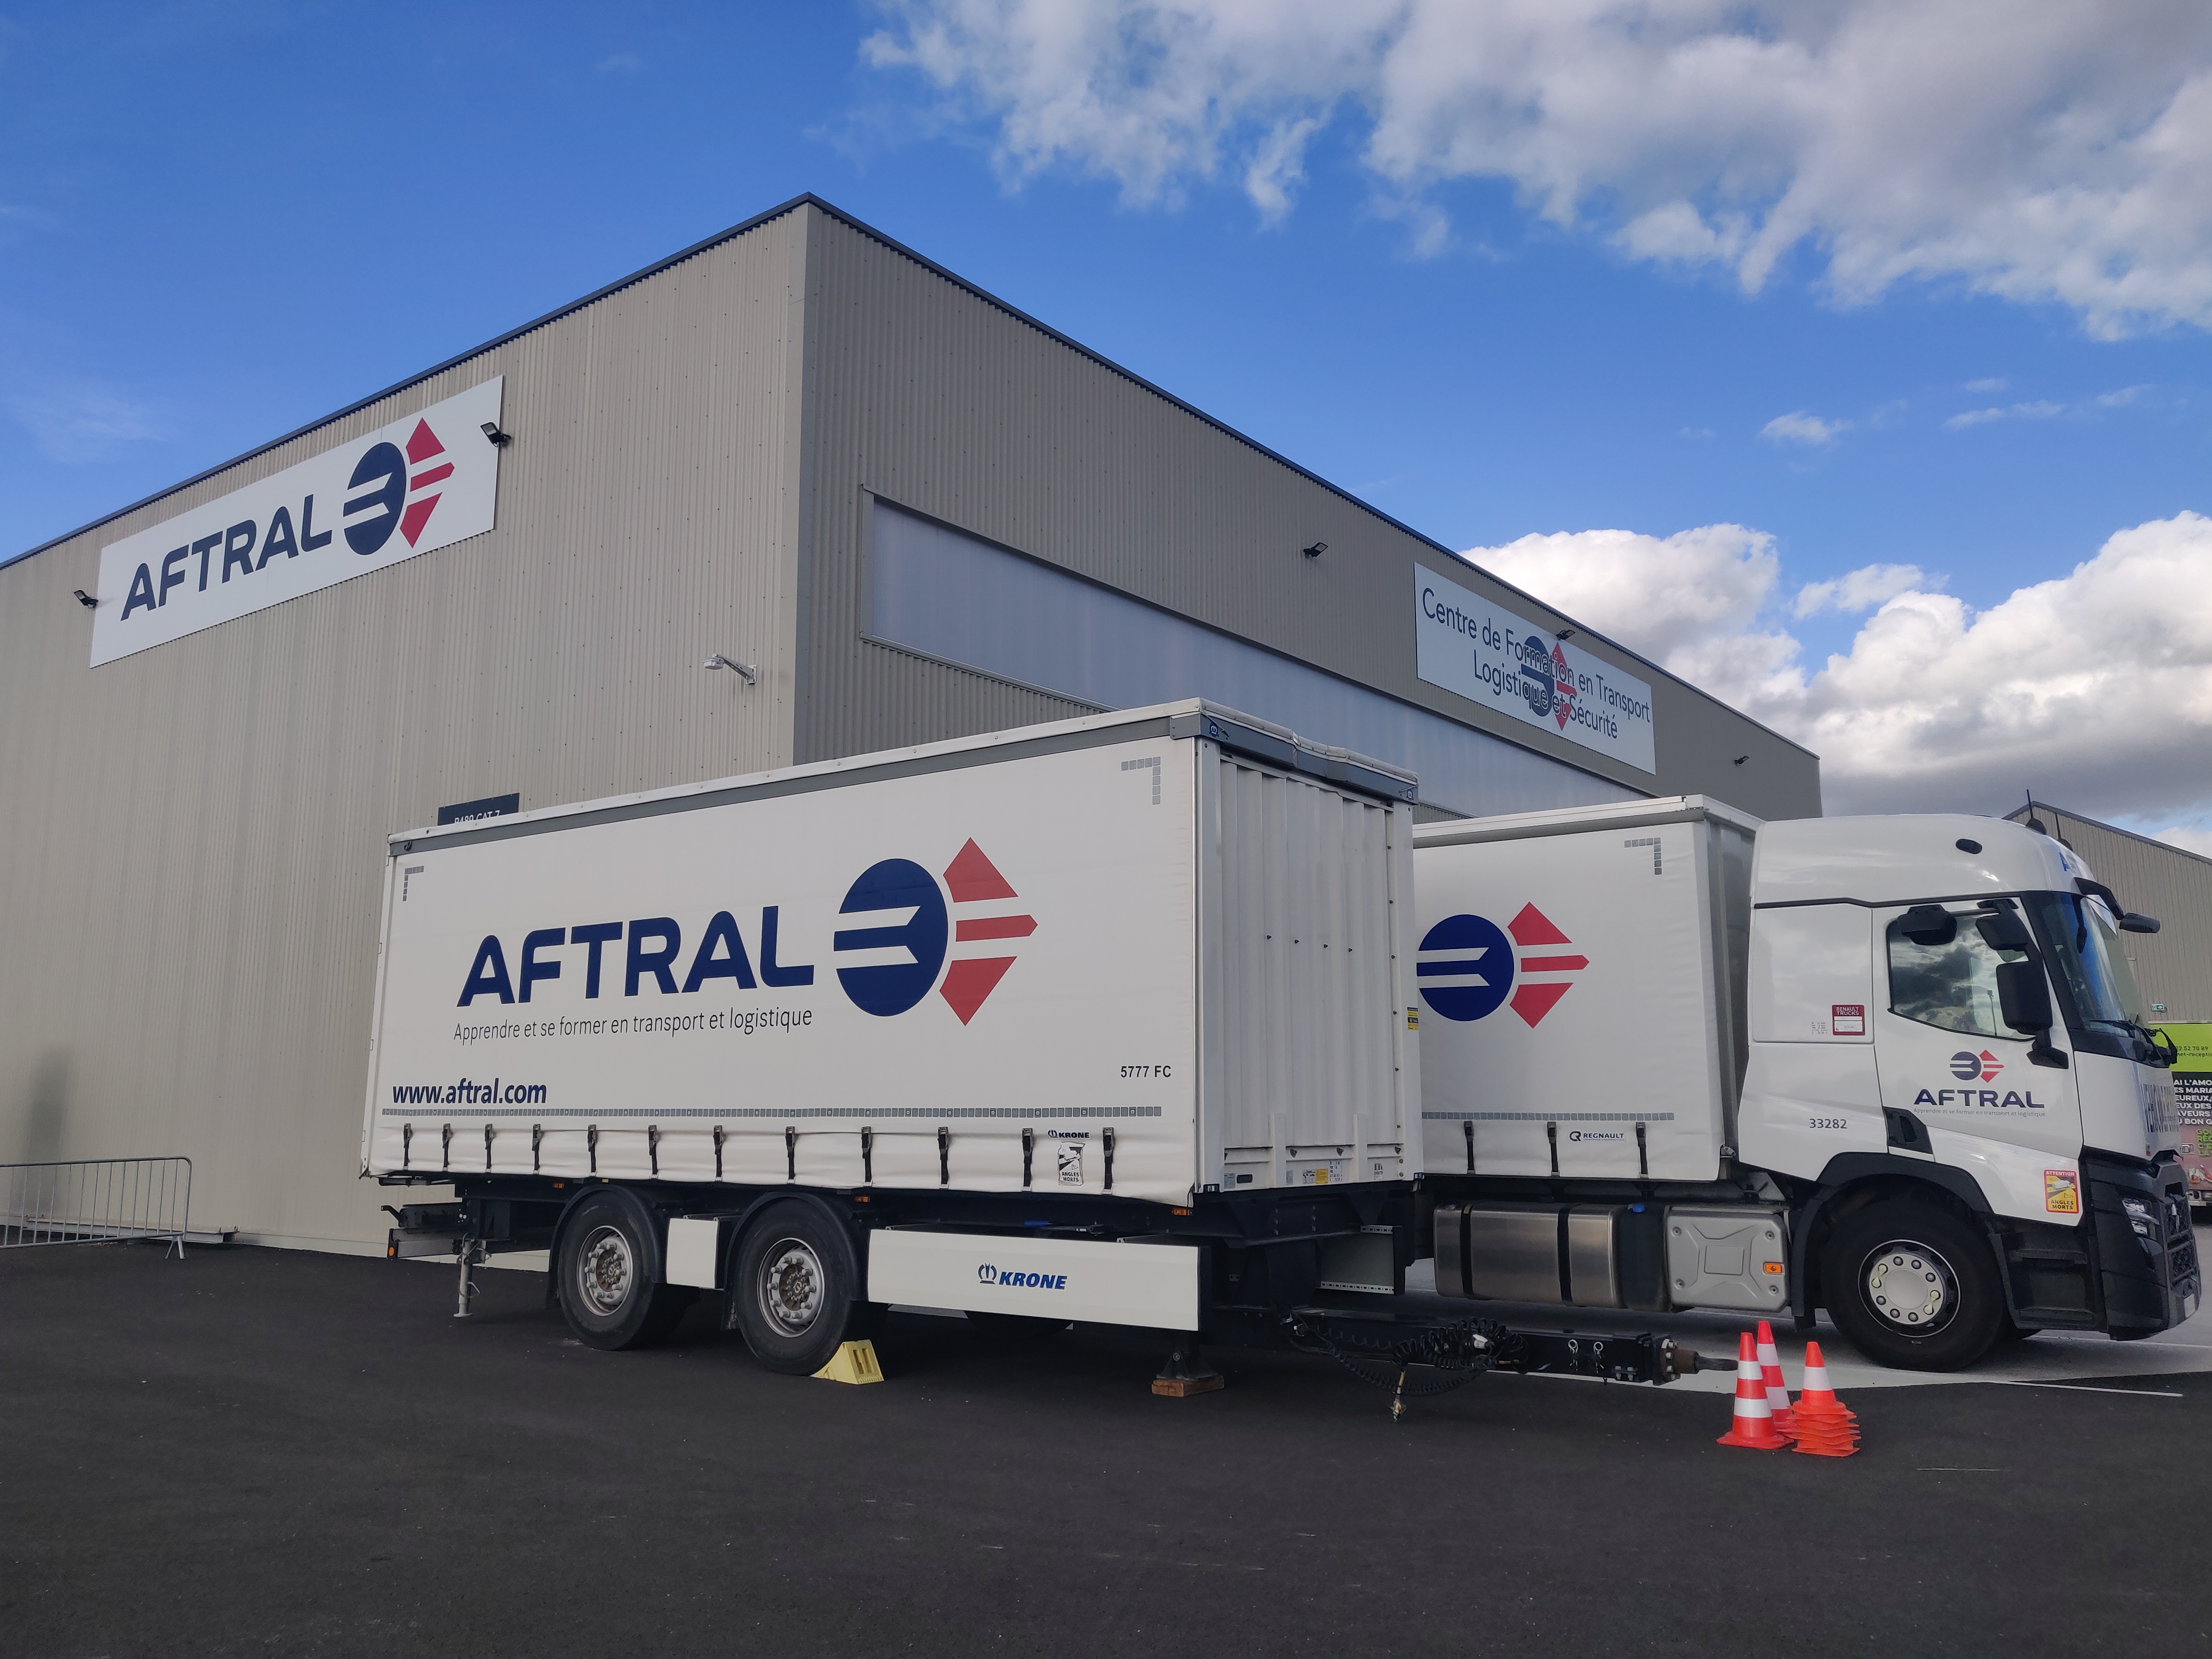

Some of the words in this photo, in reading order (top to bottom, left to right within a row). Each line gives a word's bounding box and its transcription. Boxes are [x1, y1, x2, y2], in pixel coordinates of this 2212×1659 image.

[120, 494, 332, 621] AFTRAL
[1422, 588, 1477, 639] Centre
[1482, 617, 1501, 650] de
[1506, 628, 1575, 686] Formation
[1579, 673, 1593, 696] en
[1596, 674, 1650, 723] Transport
[1474, 649, 1549, 709] Logistique
[1552, 694, 1566, 717] et
[1569, 694, 1618, 739] Sécurité
[457, 905, 815, 1007] AFTRAL
[454, 1019, 520, 1046] Apprendre
[524, 1021, 537, 1037] et
[541, 1022, 555, 1036] se
[560, 1016, 607, 1035] former
[611, 1018, 628, 1033] en
[633, 1012, 705, 1037] transport
[709, 1011, 724, 1029] et
[730, 1006, 812, 1035] logistique
[1121, 1066, 1149, 1078] 5777
[1154, 1065, 1171, 1078] FC
[393, 1078, 547, 1104] www.aftral.com
[1913, 1089, 2045, 1108] AFTRAL
[1809, 1118, 1847, 1129] 33282
[999, 1271, 1068, 1290] KRONE
